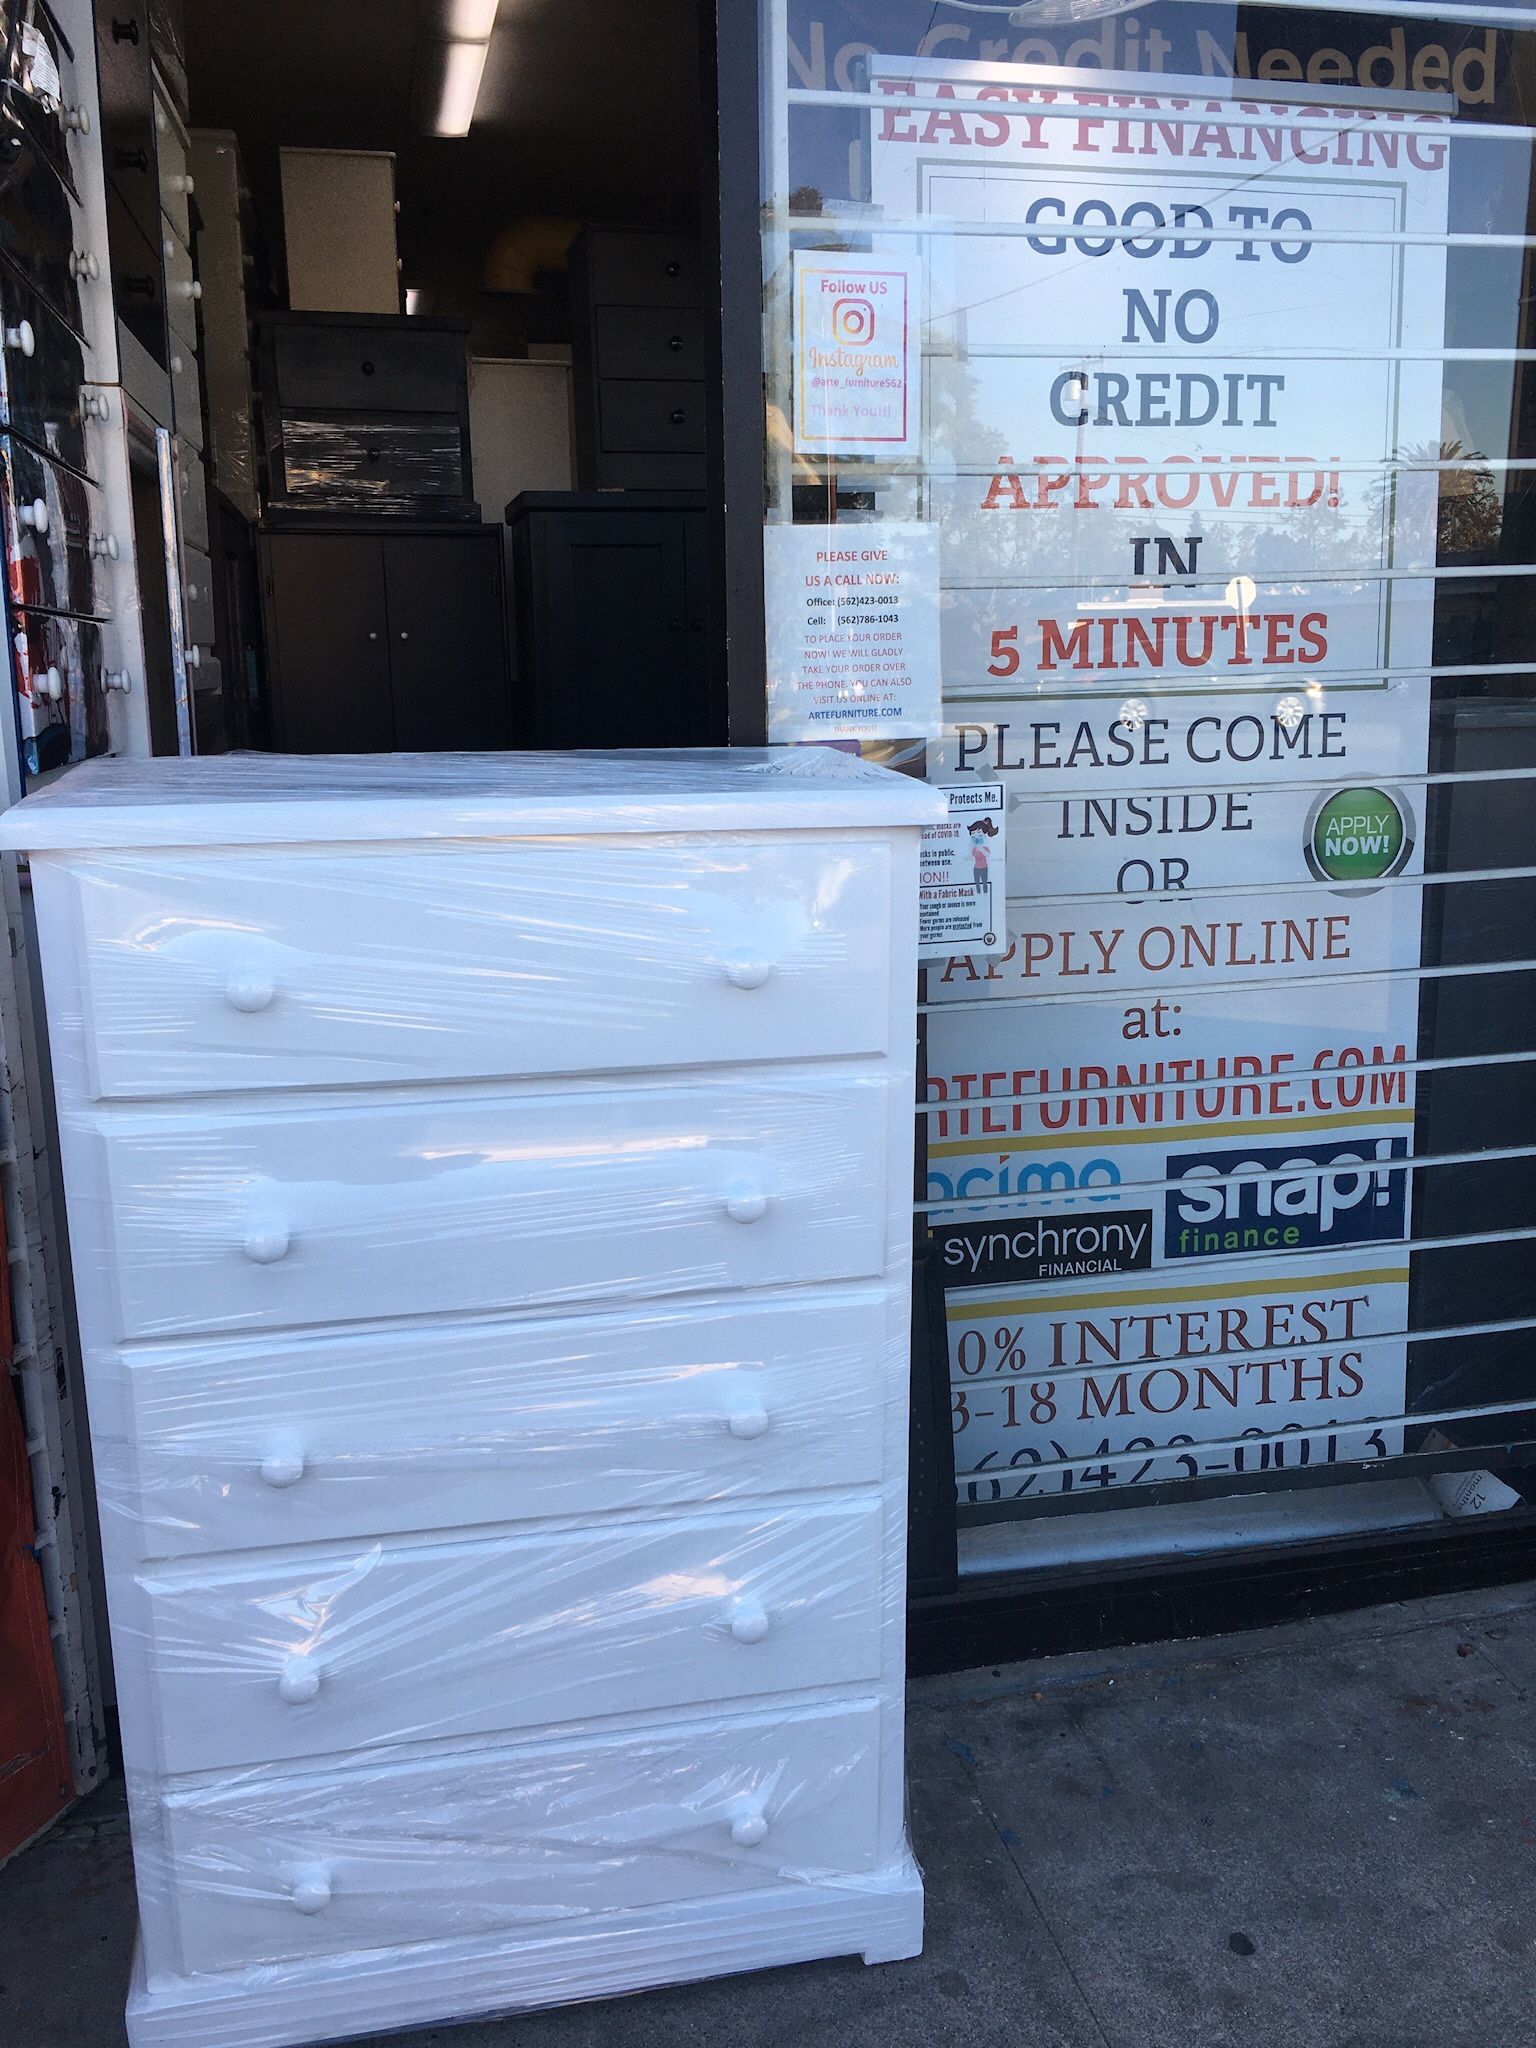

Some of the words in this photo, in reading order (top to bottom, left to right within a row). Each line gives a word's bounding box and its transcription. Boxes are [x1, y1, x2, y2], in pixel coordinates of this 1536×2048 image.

[788, 22, 880, 92] No
[1196, 27, 1496, 104] Needed
[878, 80, 1060, 149] EASY
[1073, 92, 1448, 171] FINANCING
[1025, 197, 1212, 261] GOOD
[1229, 206, 1314, 265] TO
[821, 279, 866, 294] Follow
[869, 281, 888, 295] US
[1121, 288, 1221, 345] NO
[808, 346, 900, 377] Instagram
[811, 377, 902, 390] @arte_furniture562
[810, 404, 849, 417] Thank
[1049, 371, 1285, 428] CREDIT
[980, 456, 1341, 510] APPROVED!
[816, 551, 858, 563] PLEASE
[861, 550, 888, 562] GIVE
[1128, 536, 1203, 589] IN
[805, 575, 820, 587] US
[823, 574, 833, 586] A
[835, 574, 862, 586] CALL
[865, 573, 900, 585] NOW:
[806, 597, 835, 607] Office:
[837, 595, 899, 608] (562)423-0013
[807, 616, 826, 626] Cell:
[837, 614, 899, 626] (562)786-1043
[804, 635, 817, 644] TO
[819, 634, 845, 643] PLACE
[847, 633, 871, 642] YOUR
[873, 632, 902, 641] ORDER
[987, 625, 1020, 677] 5
[1036, 612, 1328, 671] MINUTES
[804, 650, 830, 659] NOW!
[832, 649, 847, 658] WE
[849, 649, 869, 658] WILL
[871, 648, 903, 657] GLADLY
[802, 665, 824, 674] TAKE
[825, 665, 850, 673] YOUR
[852, 663, 881, 672] ORDER
[883, 663, 906, 672] OVER
[797, 681, 814, 690] THE
[850, 680, 869, 688] YOU
[870, 678, 889, 687] CAN
[890, 677, 912, 686] ALSO
[813, 696, 834, 704] VISIT
[836, 695, 848, 704] US
[850, 694, 881, 703] ONLINE
[882, 693, 897, 702] AT:
[808, 707, 902, 720] ARTEFURNITURE.COM
[833, 725, 855, 733] THANK
[954, 717, 1170, 772] PLEASE
[1186, 712, 1347, 763] COME
[950, 793, 983, 805] Protects
[984, 791, 998, 803] Me.
[1056, 792, 1253, 839] INSIDE
[1326, 814, 1390, 836] APPLY
[1325, 835, 1390, 857] NOW!
[1116, 857, 1192, 904] OR
[938, 889, 957, 899] Fabric
[958, 888, 974, 897] Mask
[940, 928, 1129, 983] APPLY
[1138, 916, 1352, 971] ONLINE
[1121, 998, 1182, 1041] at:
[1177, 1139, 1394, 1232] snap!
[943, 1220, 1148, 1274] synchrony
[1179, 1224, 1301, 1254] finance
[1038, 1258, 1122, 1277] FINANCIAL
[957, 1326, 1026, 1376] 0%
[1049, 1295, 1371, 1367] INTEREST
[1076, 1352, 1365, 1420] MONTHS
[1456, 1474, 1482, 1511] months
[1469, 1492, 1487, 1510] 12
